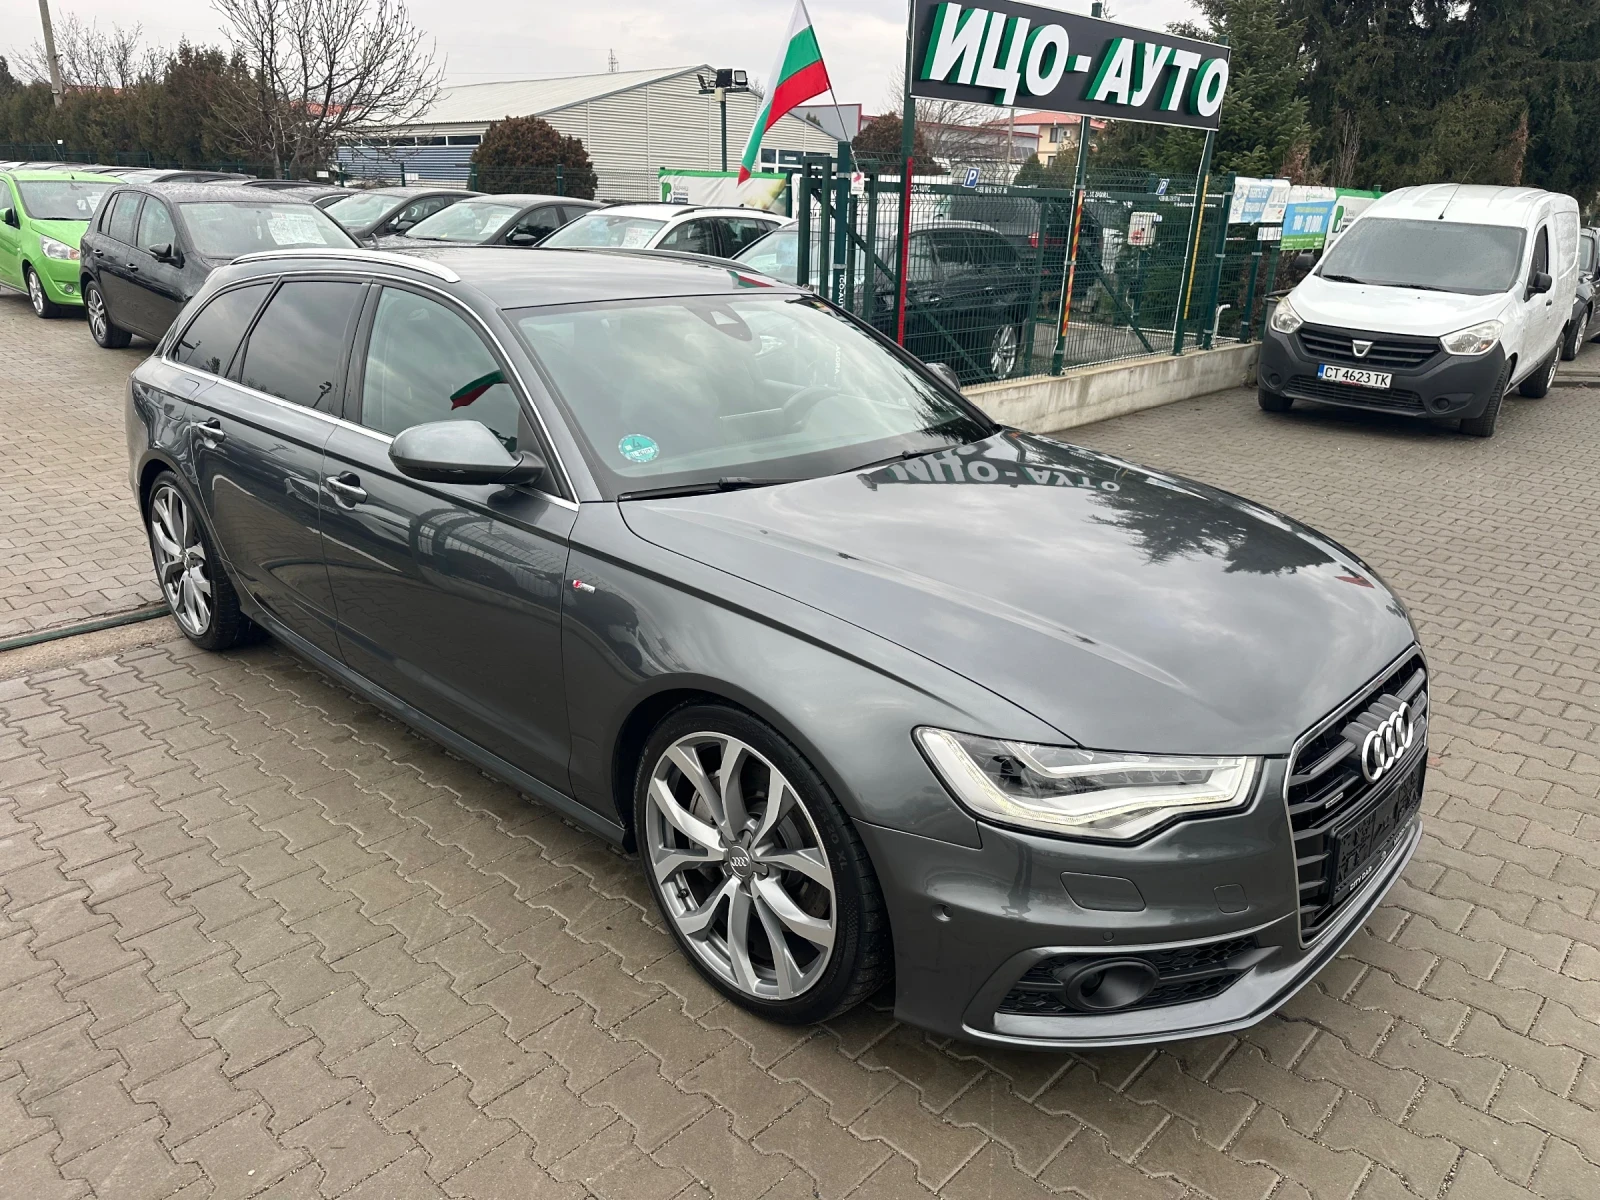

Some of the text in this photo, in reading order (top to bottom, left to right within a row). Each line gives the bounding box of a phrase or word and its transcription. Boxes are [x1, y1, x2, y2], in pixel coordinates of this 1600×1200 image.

[1325, 367, 1341, 379] CT
[1342, 369, 1371, 383] 4623
[1374, 373, 1389, 386] TK
[826, 823, 840, 845] 20
[836, 850, 848, 871] XL
